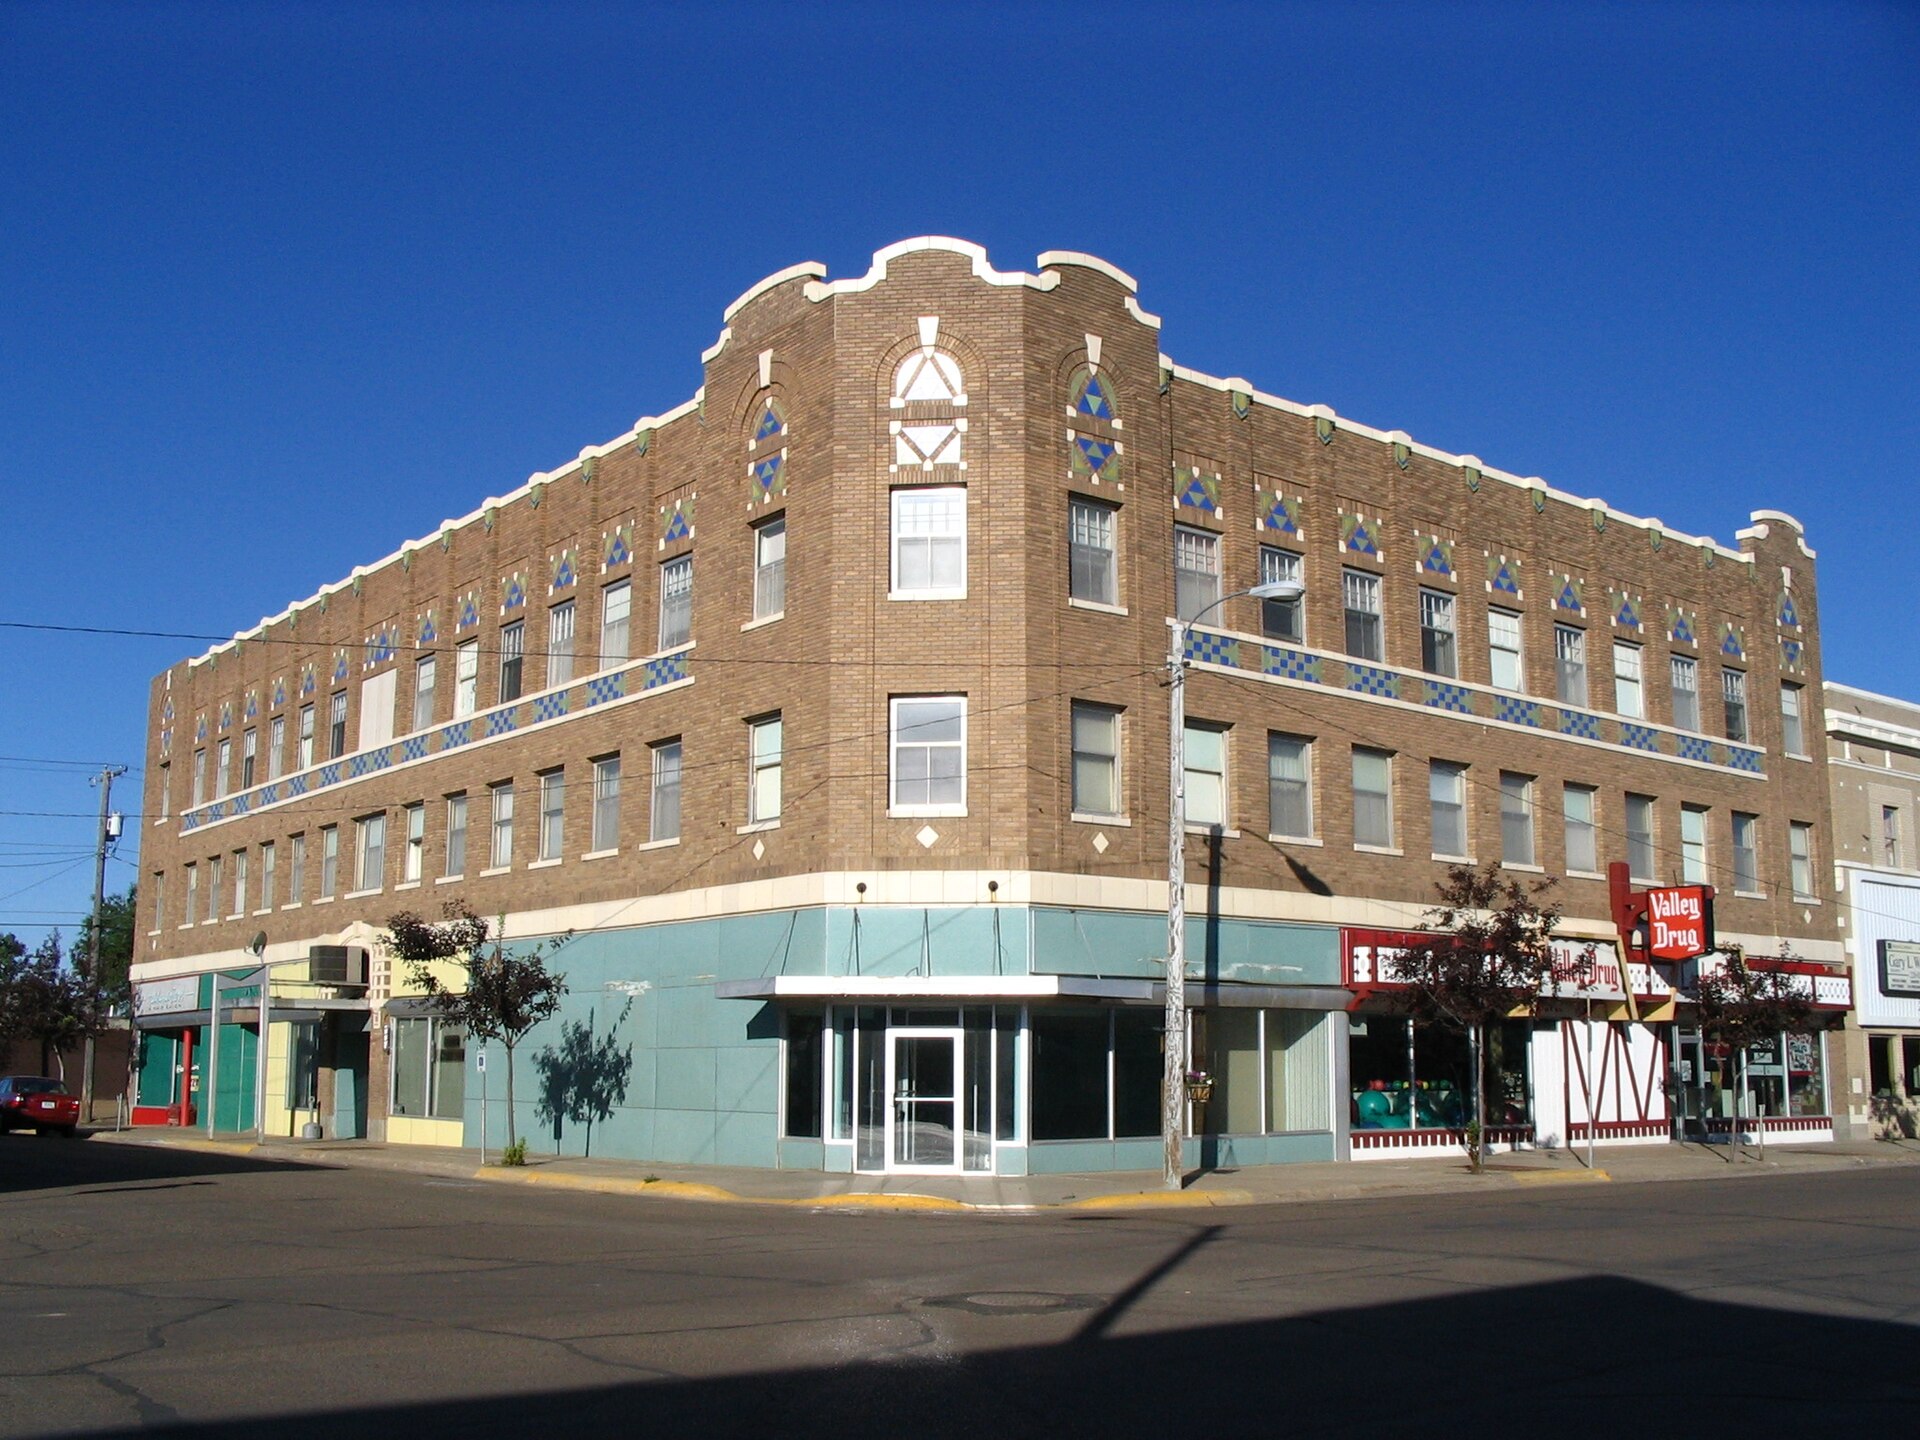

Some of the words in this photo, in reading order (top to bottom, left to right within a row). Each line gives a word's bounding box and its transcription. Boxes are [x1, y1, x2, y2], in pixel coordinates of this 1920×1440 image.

[1650, 891, 1701, 920] Valley
[1653, 922, 1701, 952] Drug
[1586, 948, 1619, 993] Drug
